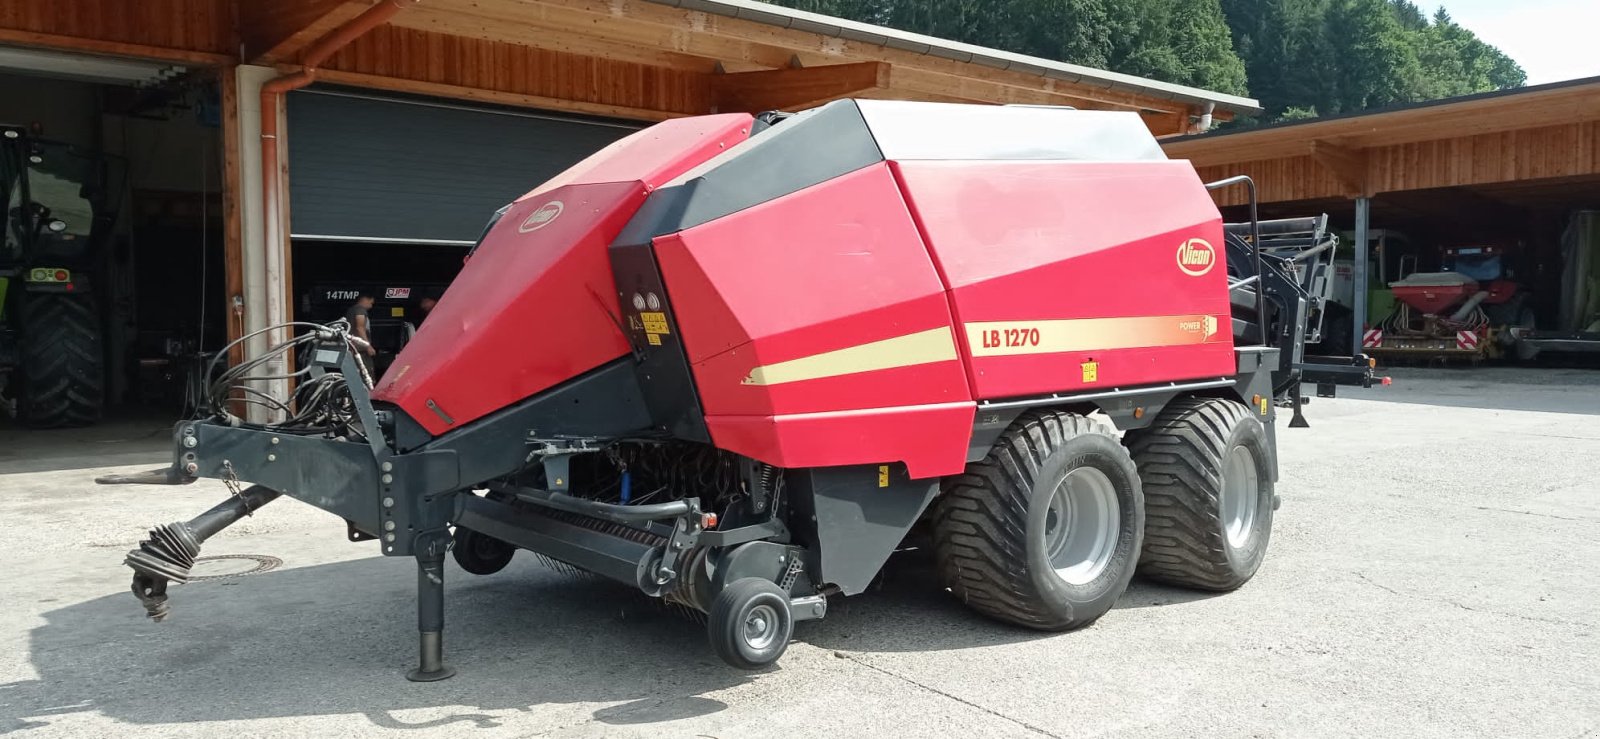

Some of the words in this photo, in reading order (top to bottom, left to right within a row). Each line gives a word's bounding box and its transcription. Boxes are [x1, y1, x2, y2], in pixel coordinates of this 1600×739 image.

[1180, 239, 1211, 266] Vicon
[326, 290, 360, 300] 14TMP
[1179, 321, 1201, 330] POWER
[983, 329, 1001, 348] LB
[1004, 327, 1040, 347] 1270
